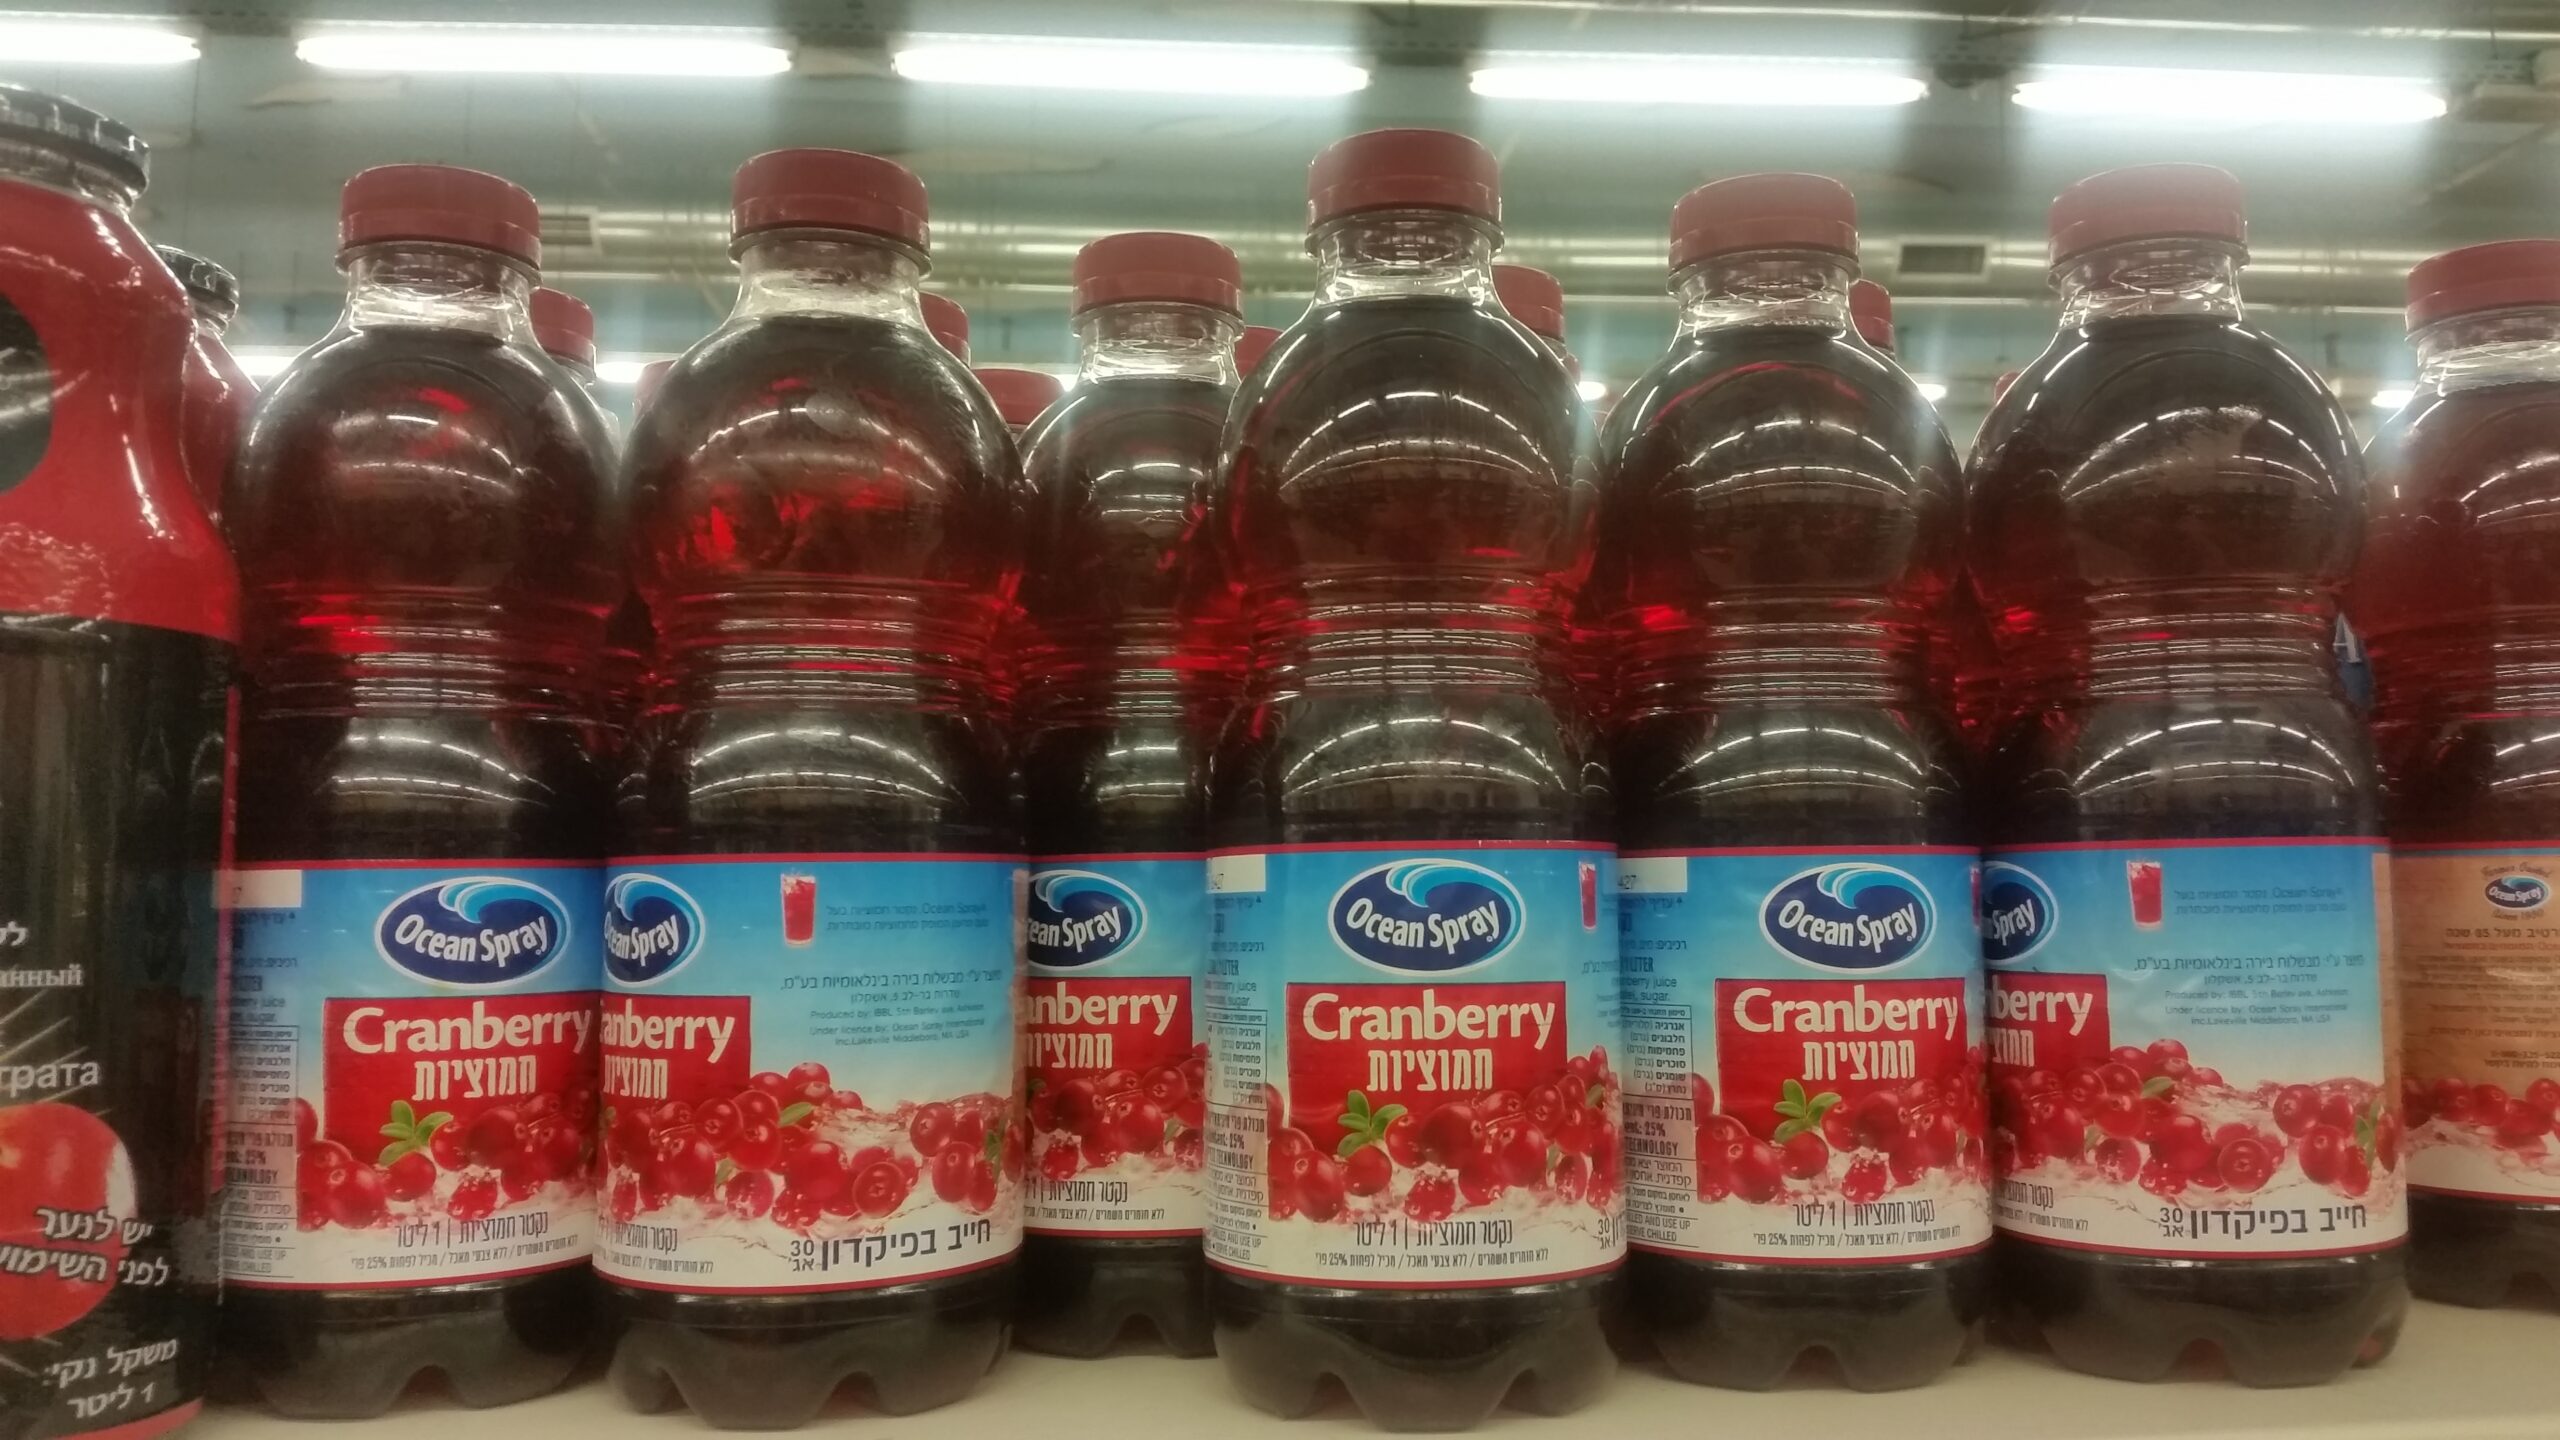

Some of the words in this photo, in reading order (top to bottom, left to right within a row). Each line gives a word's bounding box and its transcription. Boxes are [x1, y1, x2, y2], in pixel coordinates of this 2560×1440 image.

[2488, 886, 2516, 902] Ocean
[2516, 886, 2543, 904] Spray
[1027, 918, 1060, 947] ean
[1062, 906, 1121, 953] Spray
[1346, 898, 1424, 948] Ocean
[1428, 900, 1500, 955] Spray
[1778, 899, 1854, 947] Ocean
[1857, 903, 1918, 953] Spray
[1991, 898, 2036, 947] Spray
[395, 914, 475, 962] Ocean
[481, 916, 548, 967] Spray
[631, 914, 679, 967] Spray
[2174, 957, 2242, 970] בינלאומיות
[2246, 957, 2274, 969] בירה
[2278, 955, 2321, 968] מבשלות
[822, 975, 888, 989] בינלאומיות
[893, 974, 919, 987] בירה
[1653, 977, 1677, 989] juice
[1733, 984, 1958, 1041] Cranberry
[1990, 973, 2094, 1037] berry
[343, 1001, 591, 1055] Cranberry
[1303, 988, 1555, 1050] Cranberry
[1655, 1021, 1685, 1031] אנרגיה
[600, 998, 735, 1064] anberry
[1651, 1034, 1685, 1043] חלבונים
[1647, 1046, 1685, 1056] פחמימות
[1802, 1040, 1916, 1081] חמוציות
[1366, 1048, 1494, 1092] חמוציות
[1656, 1059, 1686, 1069] סוכרים
[411, 1055, 537, 1101] חמוציות
[1655, 1071, 1686, 1081] שומנים
[1663, 1106, 1692, 1121] תכולת
[1645, 1121, 1666, 1137] 25%
[1625, 1136, 1679, 1156] TECHNOLOGY
[1654, 1160, 1682, 1173] המוצר
[1048, 1181, 1095, 1201] חמוציות
[1099, 1181, 1128, 1206] נקטר
[2031, 1184, 2054, 1211] נקטר
[1645, 1215, 1661, 1228] AND
[1662, 1218, 1677, 1230] USE
[1679, 1219, 1691, 1231] UP
[1792, 1203, 1825, 1227] ליטר
[1854, 1201, 1906, 1226] חמוציות
[1910, 1199, 1935, 1227] נקטר
[2159, 1206, 2184, 1223] 30
[2319, 1204, 2367, 1232] חייב
[37, 1207, 115, 1240] לנער
[121, 1219, 153, 1244] יש
[458, 1216, 516, 1245] חמוציות
[520, 1211, 549, 1239] נקטר
[1355, 1219, 1386, 1246] ליטר
[1416, 1220, 1476, 1247] חמוציות
[1481, 1218, 1513, 1248] נקטר
[1598, 1217, 1610, 1235] 30
[2190, 1209, 2309, 1240] בפיקדון
[394, 1222, 429, 1249] ליטר
[650, 1226, 678, 1254] נקטר
[948, 1218, 991, 1251] חייב
[1646, 1227, 1677, 1242] CHILLED
[1768, 1232, 1788, 1246] 25%
[1817, 1232, 1835, 1247] מכיל
[1845, 1233, 1865, 1247] מאכל
[1867, 1232, 1884, 1246] צבעי
[1886, 1232, 1899, 1246] ללא
[790, 1239, 815, 1257] 30
[822, 1228, 936, 1271] בפיקדון
[1510, 1249, 1534, 1264] חומרים
[1535, 1248, 1549, 1262] ללא
[1329, 1253, 1348, 1267] 25%
[1350, 1252, 1375, 1268] לפחות
[1376, 1252, 1396, 1268] מכיל
[1407, 1252, 1428, 1268] מאכל
[1431, 1253, 1450, 1268] צבעי
[1453, 1253, 1467, 1268] ללא
[1478, 1251, 1508, 1266] משמרים
[118, 1256, 169, 1286] לפני
[107, 1339, 177, 1376] משקל
[68, 1383, 134, 1418] ליטר
[141, 1382, 155, 1403] 1
